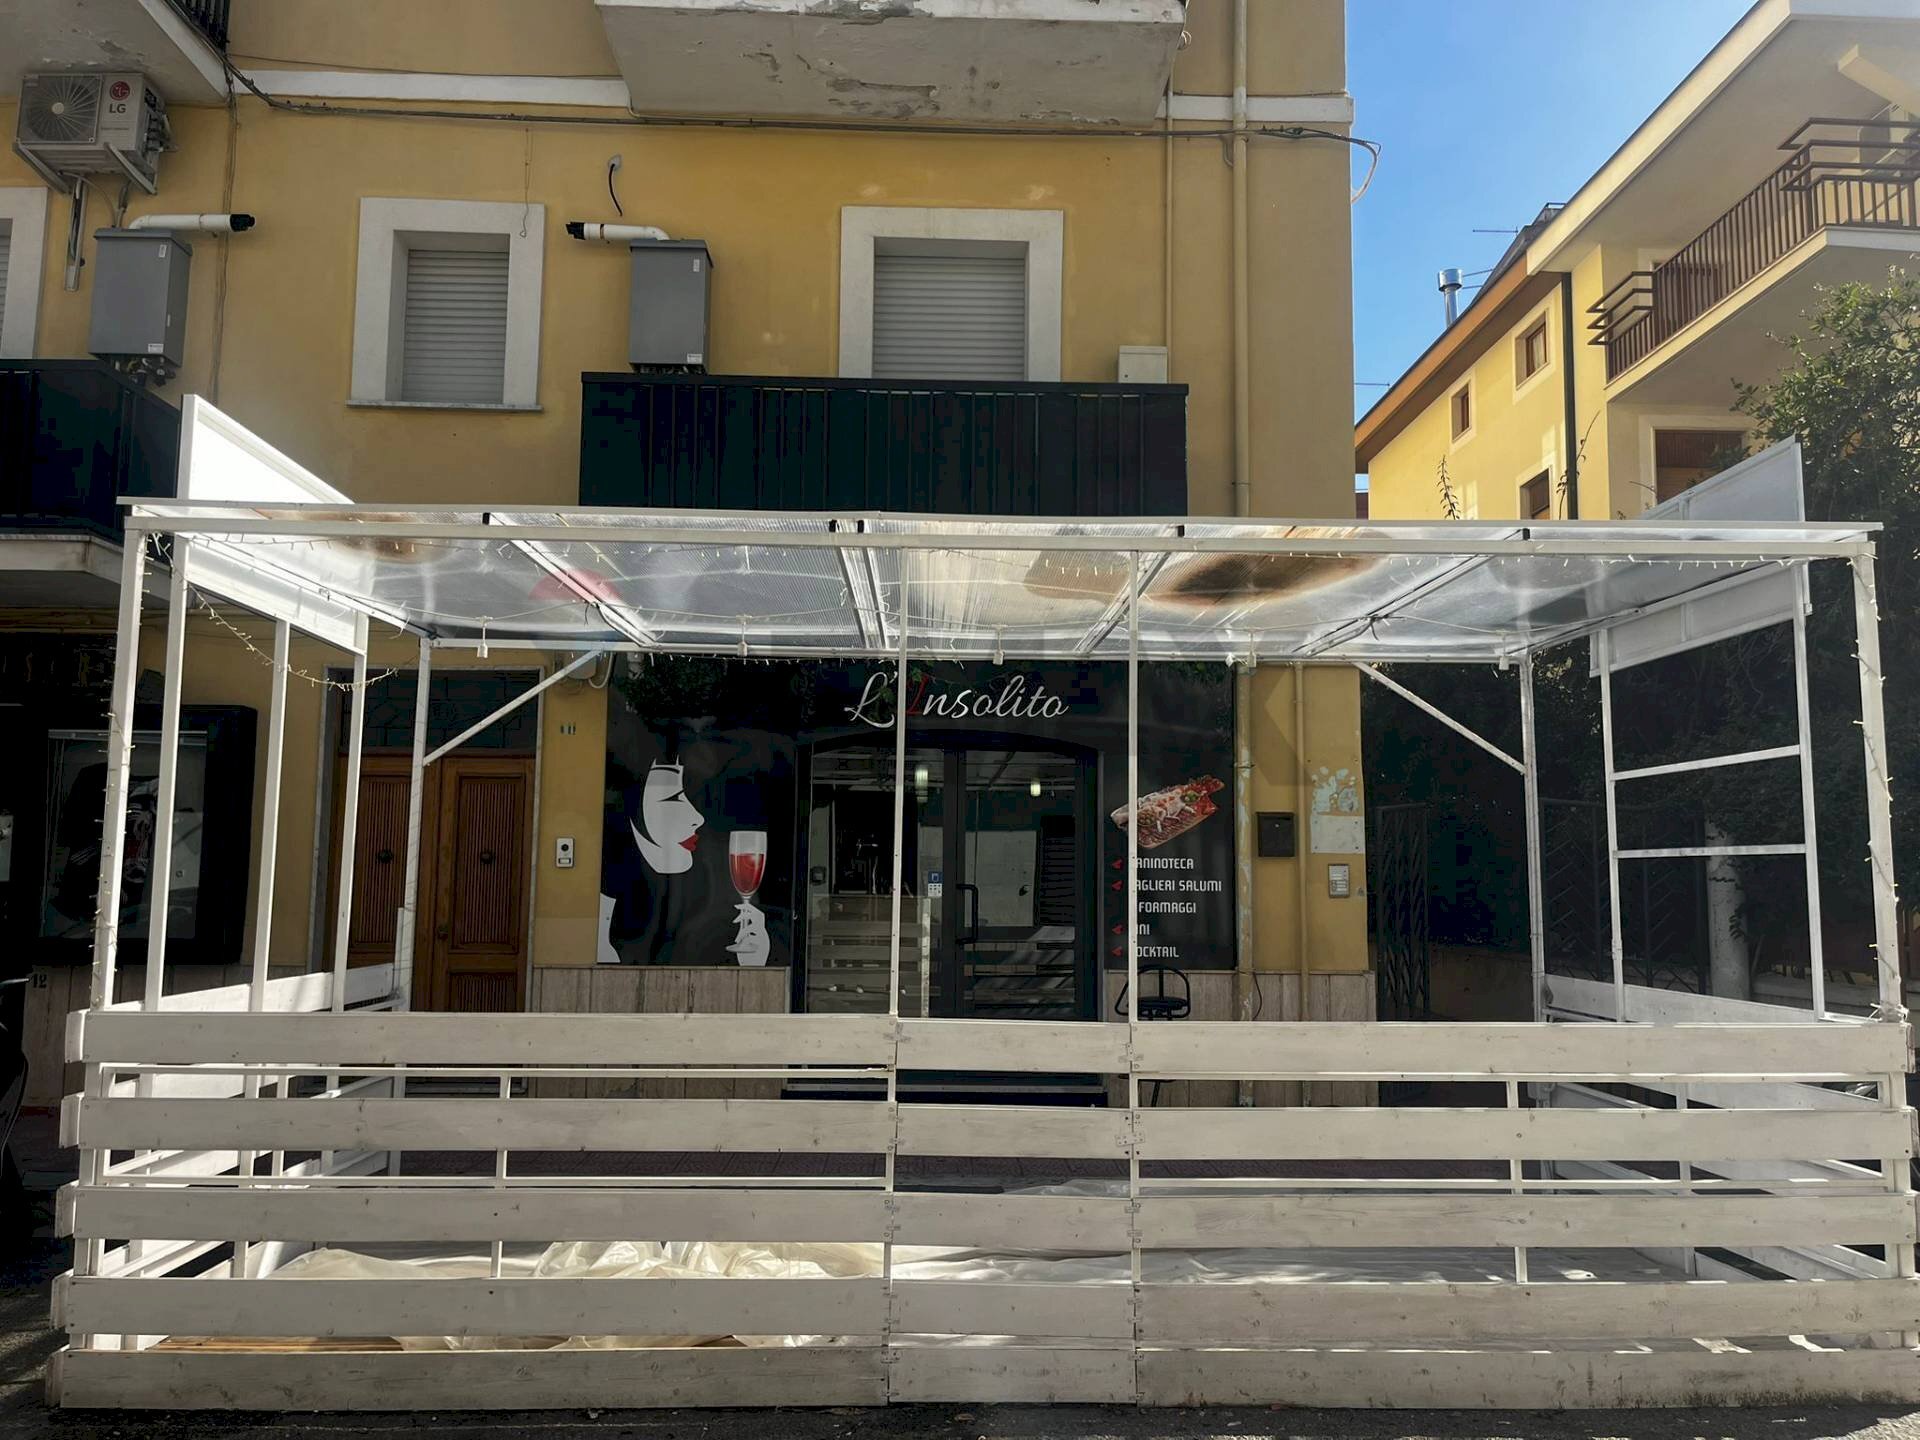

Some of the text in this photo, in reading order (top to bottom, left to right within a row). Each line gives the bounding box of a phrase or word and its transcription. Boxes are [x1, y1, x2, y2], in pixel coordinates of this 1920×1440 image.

[109, 103, 126, 114] LG
[1136, 857, 1194, 869] ANINOTECA
[1136, 879, 1222, 892] AGLIERI SALUMI
[1138, 901, 1197, 914] FORMAGGI
[1136, 946, 1180, 958] OCKTAIL
